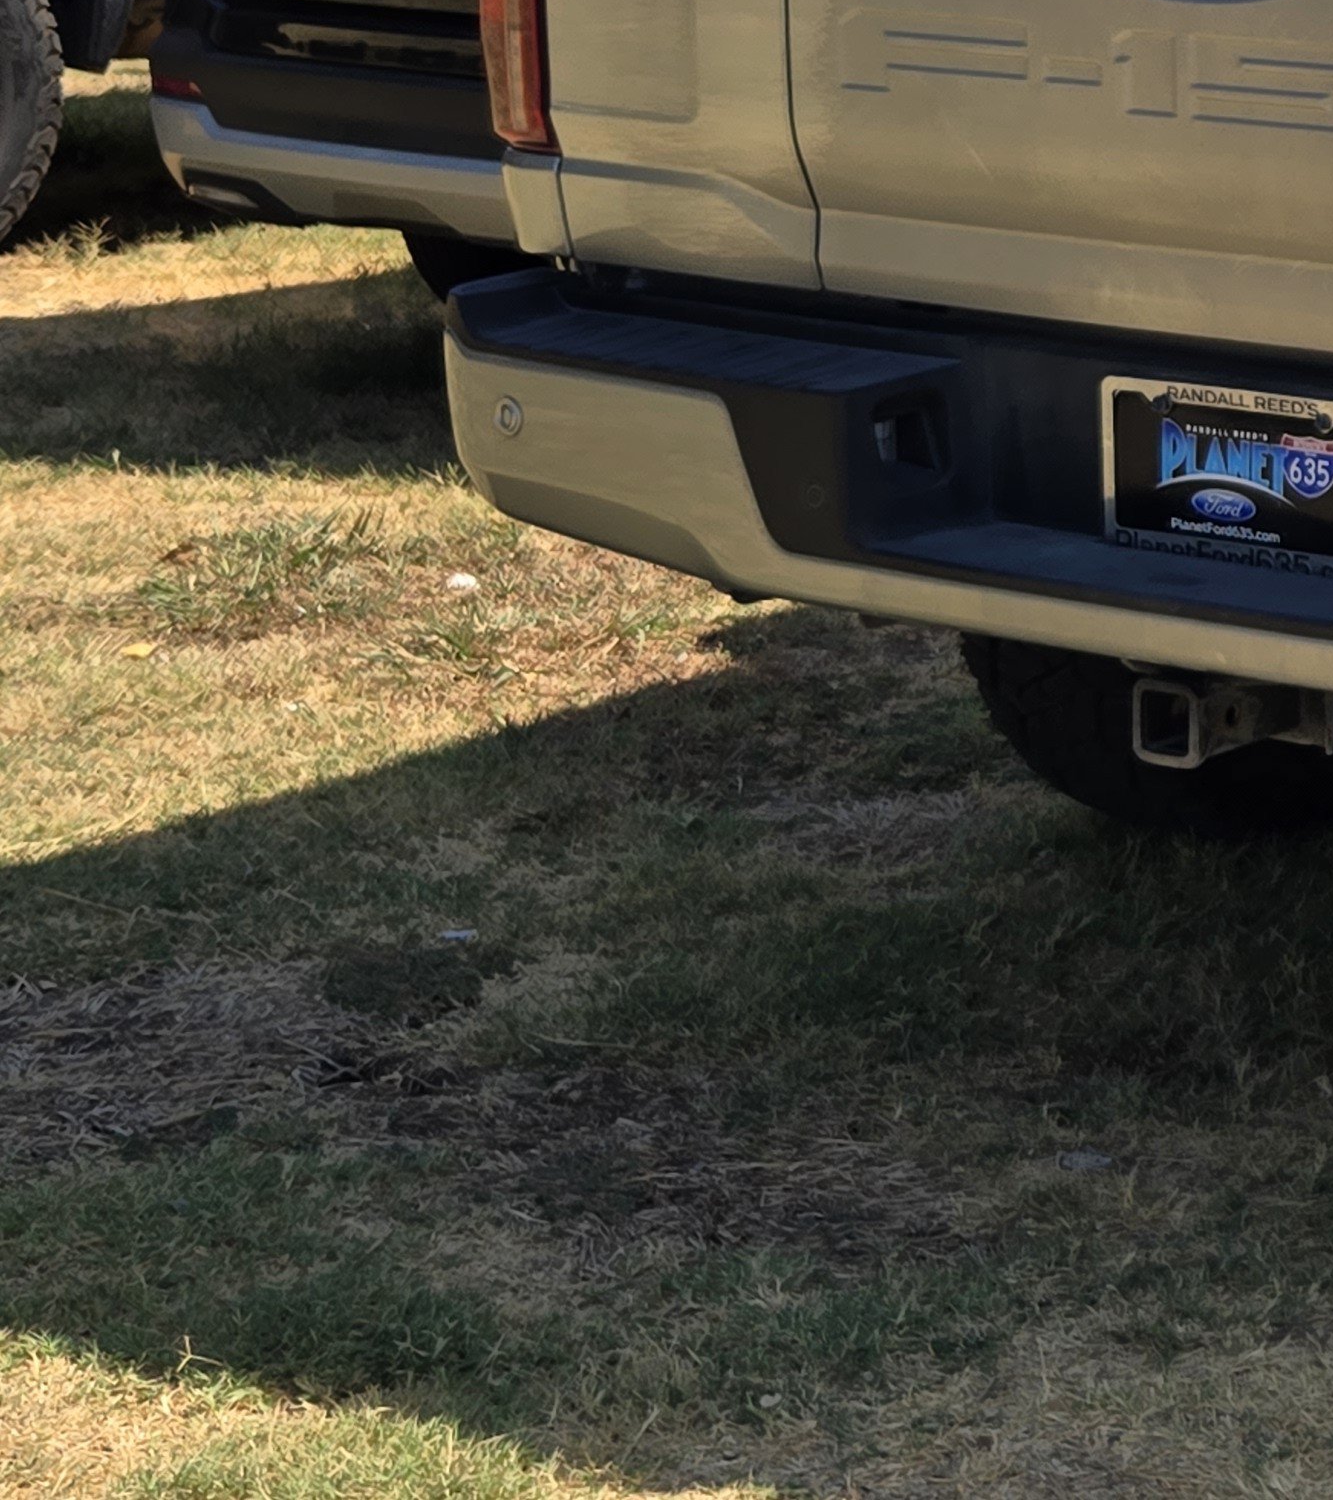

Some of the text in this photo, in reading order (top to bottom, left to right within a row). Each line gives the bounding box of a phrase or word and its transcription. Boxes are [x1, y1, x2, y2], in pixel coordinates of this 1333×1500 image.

[1166, 385, 1320, 418] RANDALL REED'S
[1161, 417, 1289, 496] PLANET
[1289, 456, 1330, 488] 635
[1202, 493, 1243, 518] Ford
[1170, 516, 1281, 544] PlanetFord635.com
